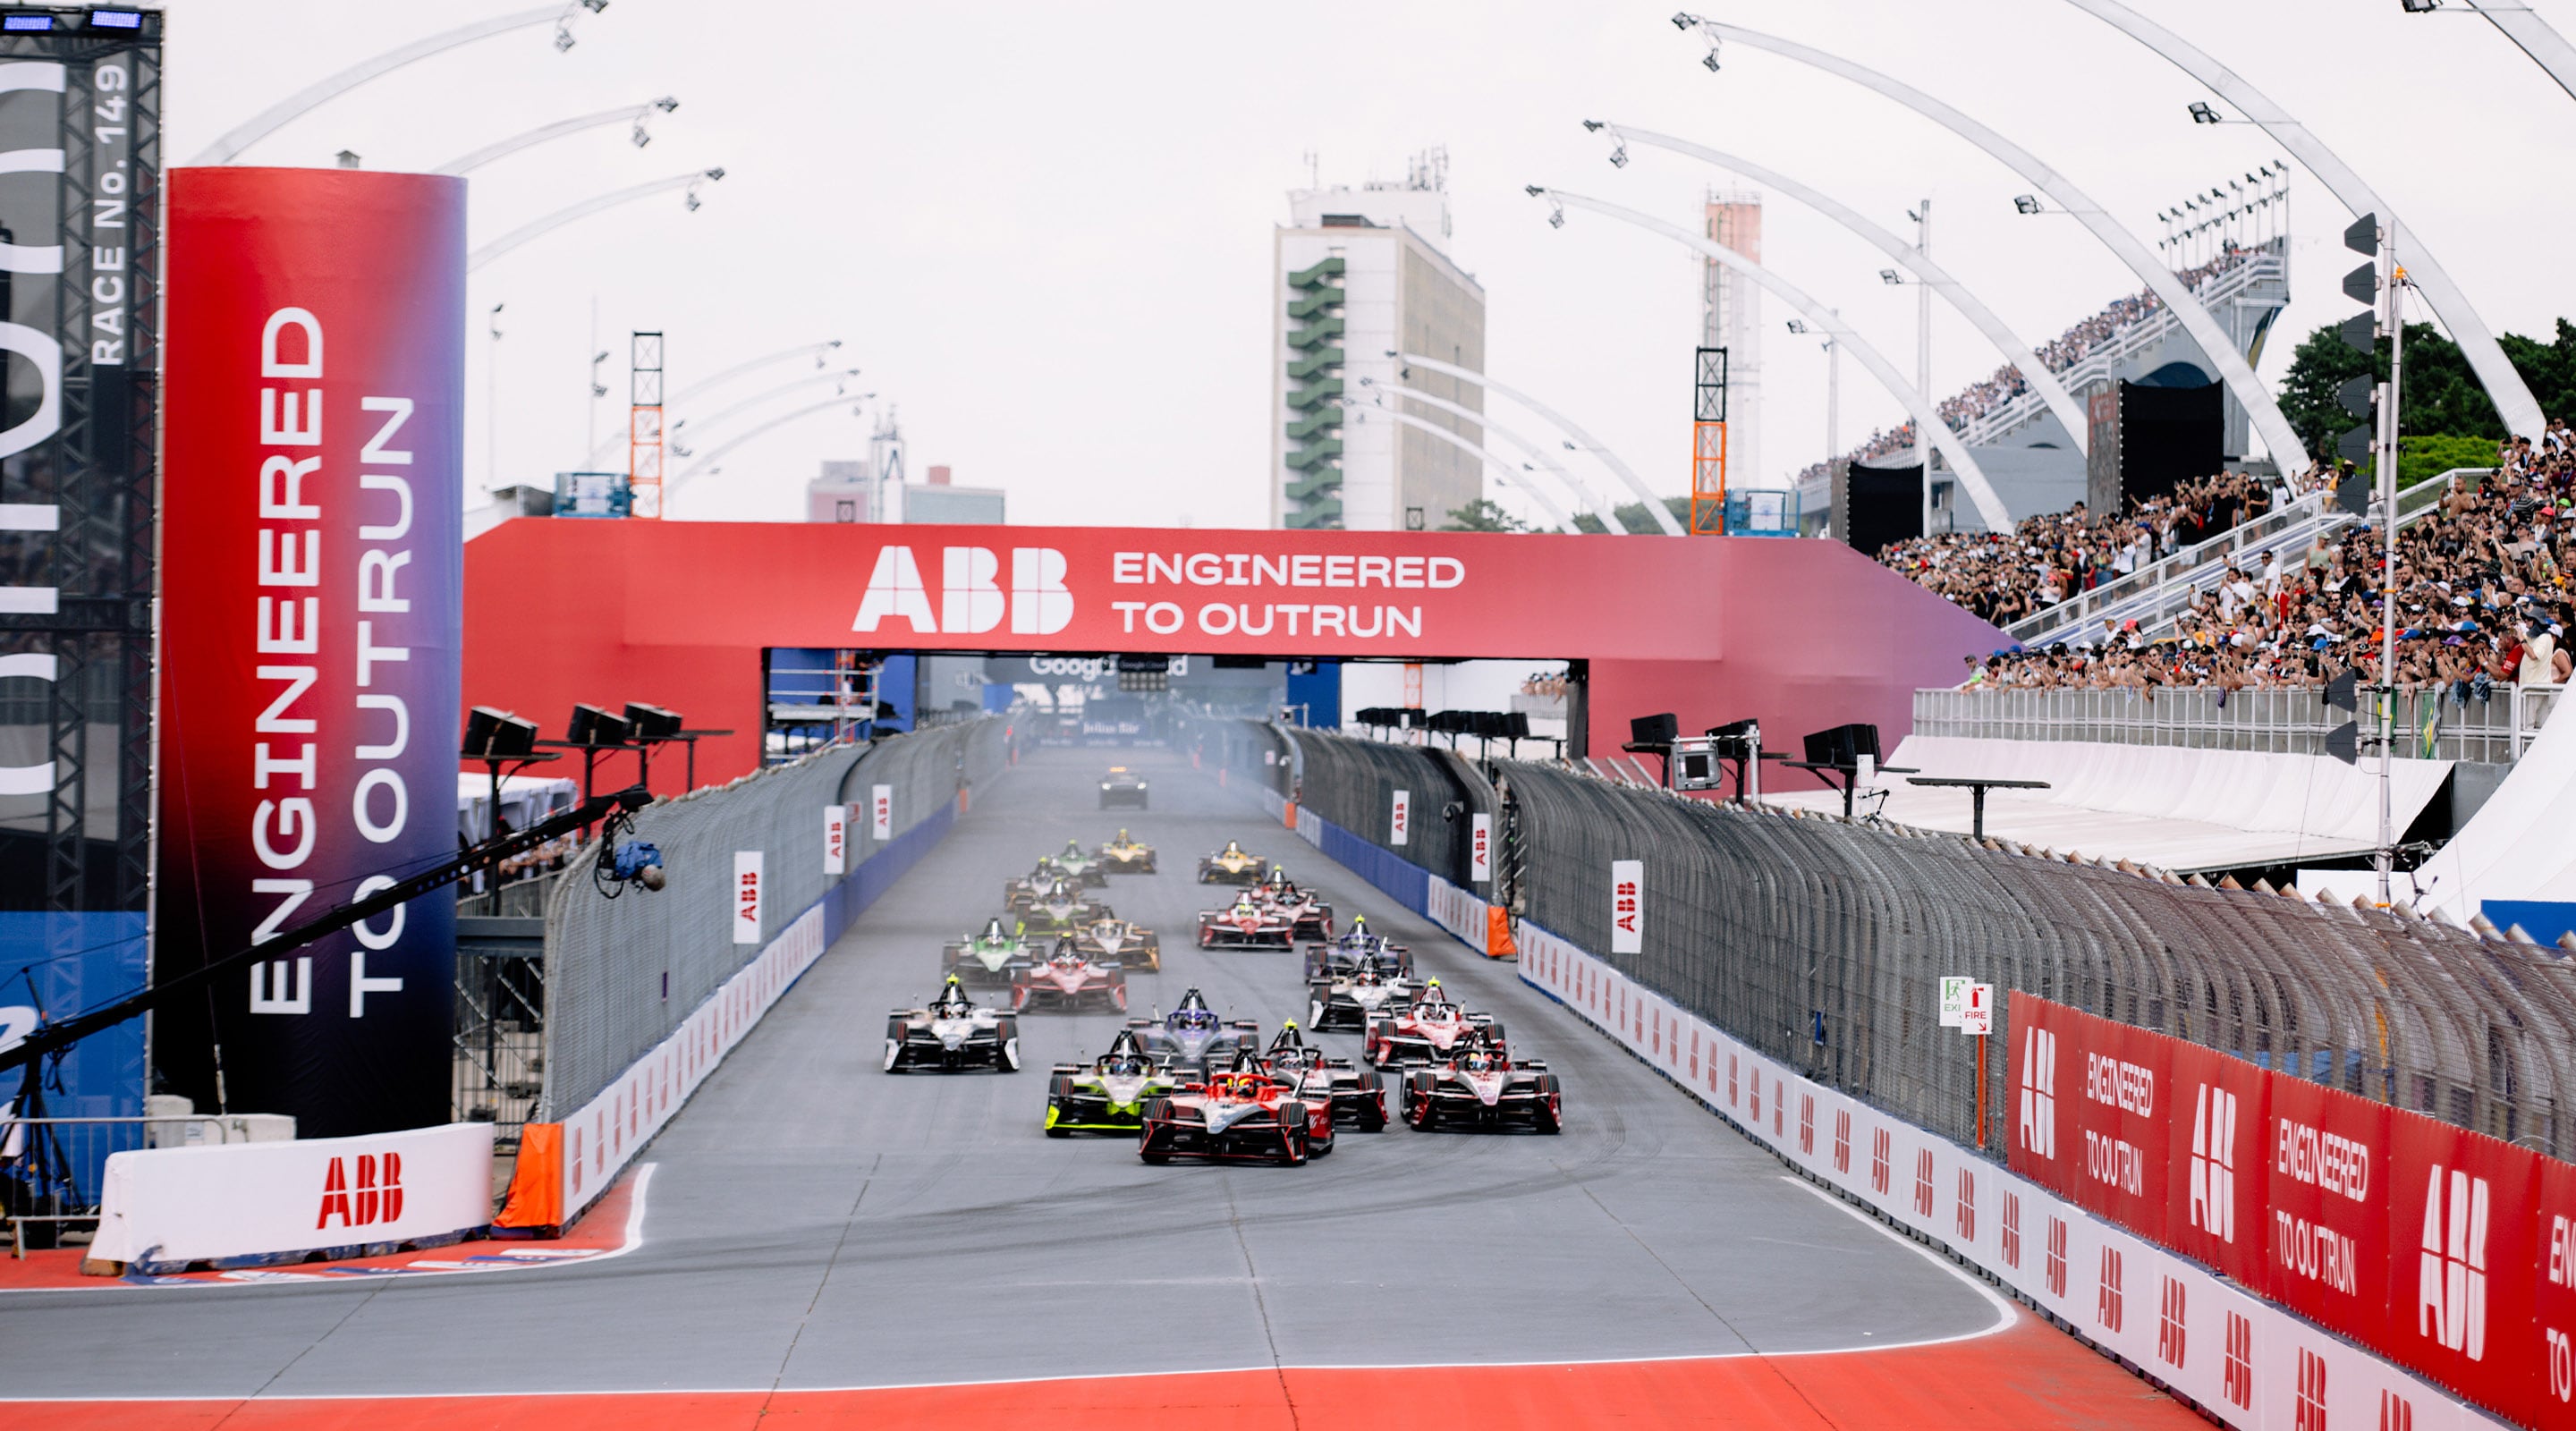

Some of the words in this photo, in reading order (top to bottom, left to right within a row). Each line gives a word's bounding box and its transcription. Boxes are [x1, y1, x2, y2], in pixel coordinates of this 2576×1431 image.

[95, 65, 127, 143] 149
[94, 160, 126, 227] No.
[92, 246, 123, 364] RACE
[853, 546, 1072, 634] ABB
[1114, 553, 1464, 588] ENGINEERED
[353, 396, 415, 843] OUTRUN
[1113, 603, 1182, 633] TO
[1199, 604, 1420, 637] OUTRUN
[250, 307, 323, 1013] ENGINEERED
[831, 822, 842, 858] ABB
[878, 798, 888, 826] ABB
[1395, 803, 1404, 832] ABB
[1475, 829, 1487, 866] ABB
[741, 873, 757, 921] ABB
[1616, 881, 1637, 933] ABB
[351, 876, 404, 1017] TO
[1944, 1003, 1961, 1012] EXI
[1964, 1011, 1987, 1020] FIRE
[2021, 1027, 2055, 1159] ABB
[2088, 1053, 2152, 1117] ENGINEERED
[1799, 1095, 1815, 1156] ABB
[1833, 1109, 1851, 1174] ABB
[2279, 1119, 2368, 1201] ENGINEERED
[318, 1153, 402, 1229] ABB
[1872, 1127, 1891, 1197] ABB
[1913, 1148, 1934, 1218] ABB
[2087, 1130, 2098, 1179] TO
[2101, 1136, 2141, 1196] OUTRUN
[2190, 1083, 2235, 1243] ABB
[1956, 1169, 1976, 1242] ABB
[2002, 1191, 2020, 1269] ABB
[2046, 1217, 2067, 1299] ABB
[2277, 1211, 2292, 1269] TO
[2297, 1219, 2354, 1294] OUTRUN
[2420, 1164, 2487, 1360] ABB
[2097, 1245, 2123, 1334] ABB
[2158, 1274, 2186, 1370] ABB
[2224, 1309, 2251, 1411] ABB
[2547, 1329, 2570, 1401] TO
